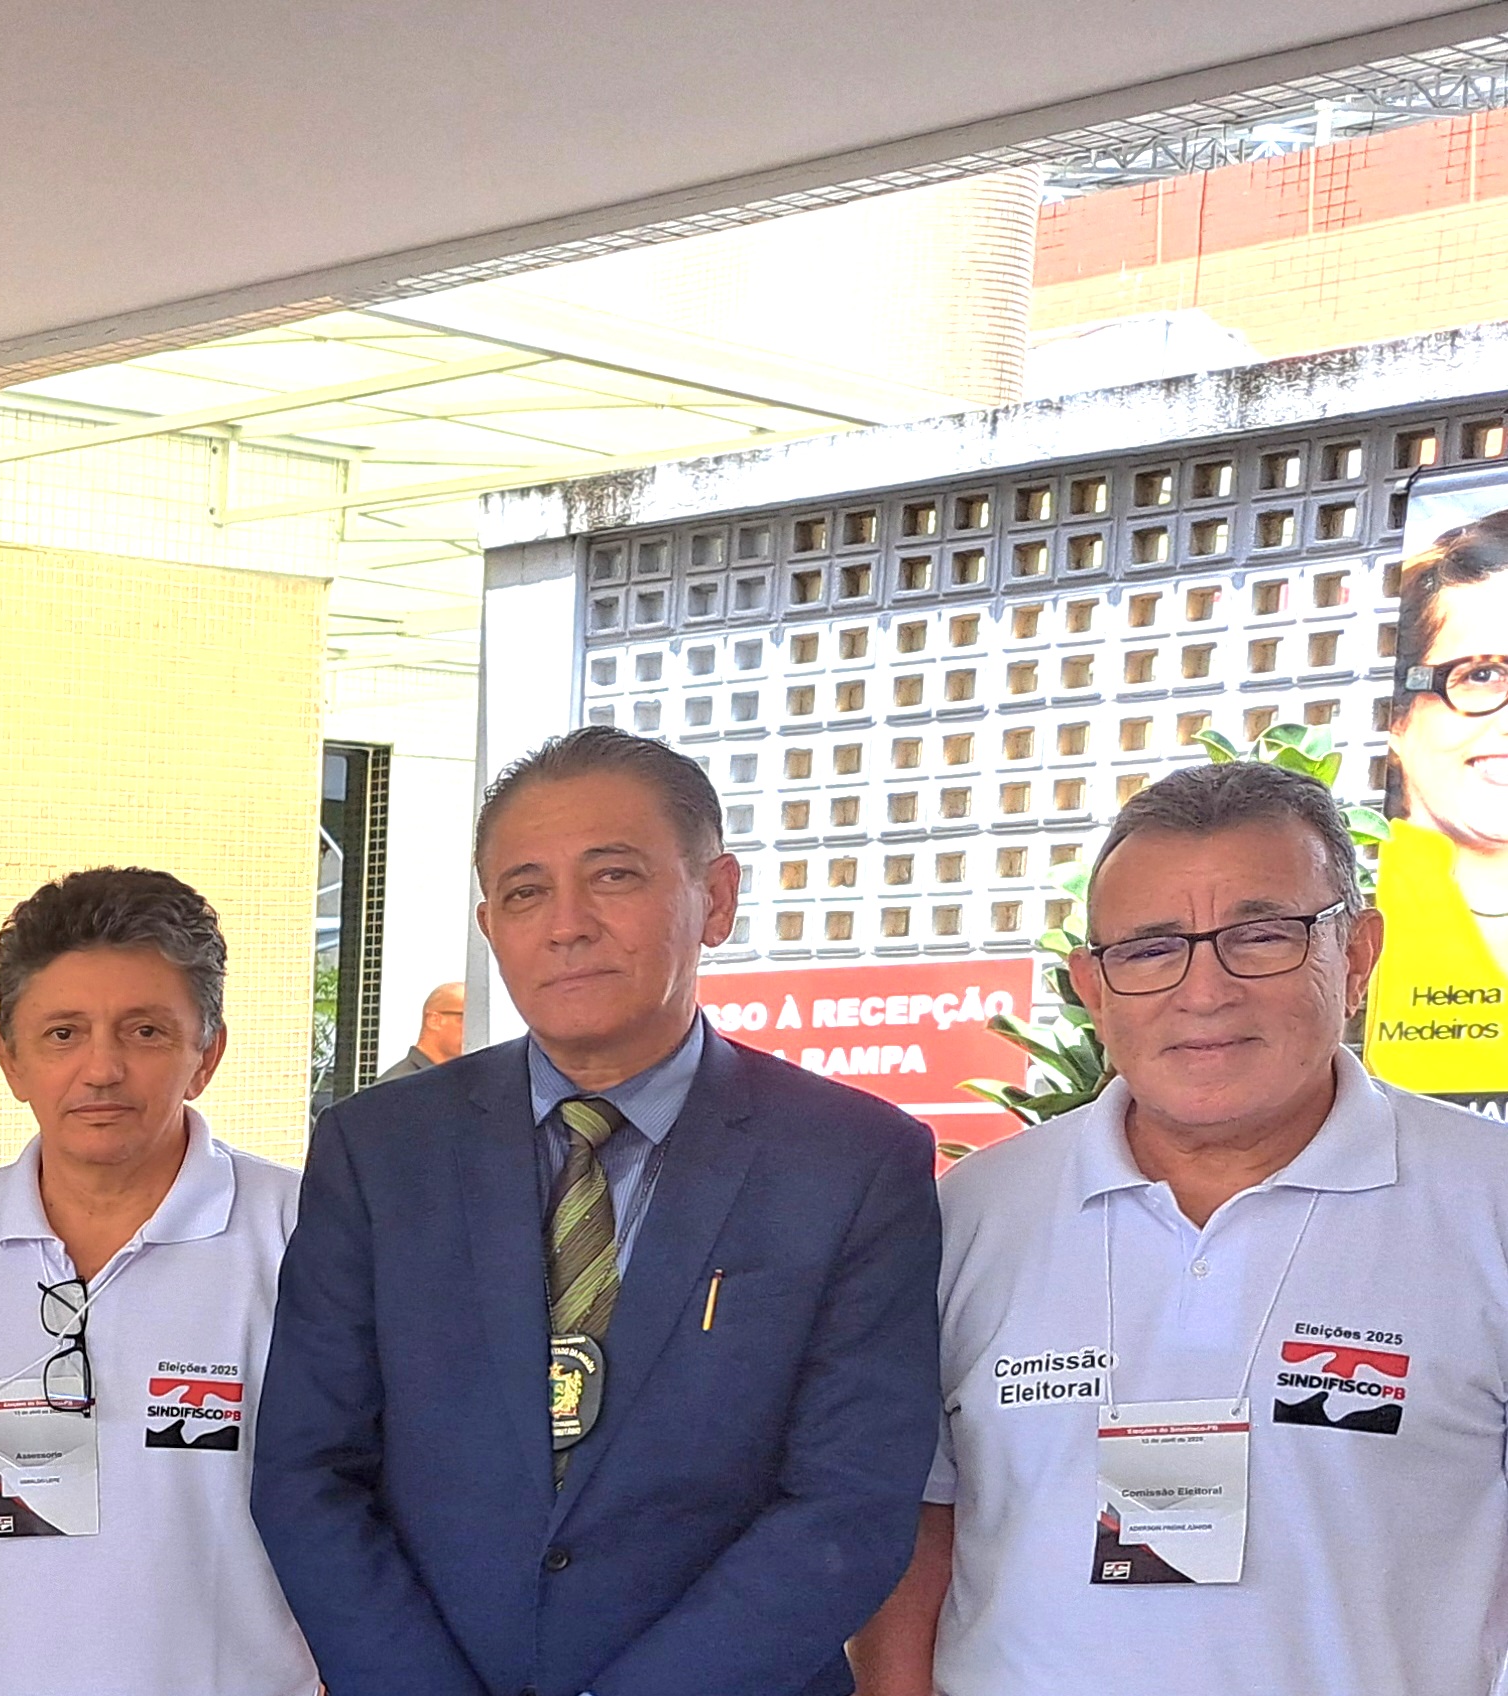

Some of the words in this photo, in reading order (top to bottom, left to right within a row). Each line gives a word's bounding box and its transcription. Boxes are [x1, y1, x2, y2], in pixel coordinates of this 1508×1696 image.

[1412, 985, 1502, 1007] Helena
[702, 1002, 768, 1032] SSO
[775, 993, 802, 1030] À
[812, 986, 1014, 1031] RECEPÇÃO
[1378, 1018, 1500, 1042] Medeiros
[800, 1045, 927, 1077] RAMPA
[1295, 1323, 1361, 1340] Eleições
[1366, 1330, 1403, 1346] 2025
[158, 1362, 207, 1374] Eleições
[210, 1364, 238, 1376] 2025
[994, 1349, 1114, 1378] Comissão
[1001, 1377, 1101, 1405] Eleitoral
[1276, 1373, 1406, 1400] SINDIFISCOPB
[147, 1405, 241, 1421] SINDIFISCOPB
[1121, 1488, 1175, 1498] Comissão
[1177, 1486, 1223, 1496] Eleitoral
